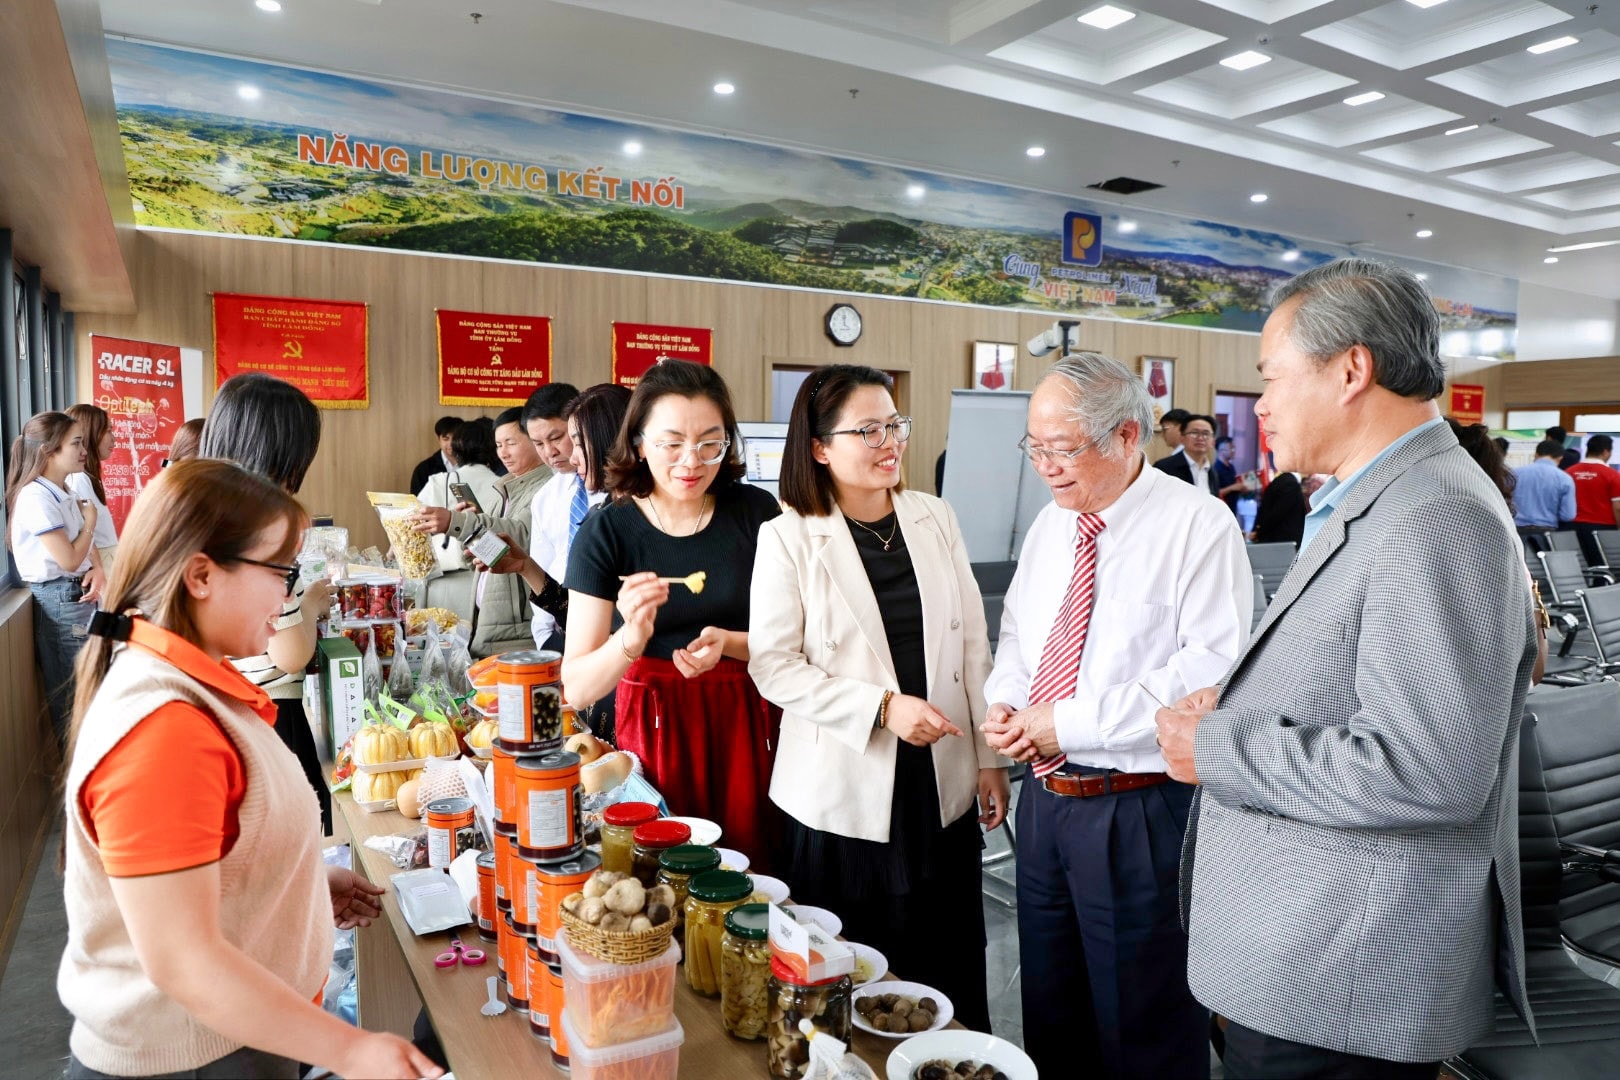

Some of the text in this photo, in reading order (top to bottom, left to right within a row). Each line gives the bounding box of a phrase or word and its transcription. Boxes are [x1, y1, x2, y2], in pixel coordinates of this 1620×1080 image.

[297, 131, 685, 209] NĂNG LƯỢNG KẾT NỐI
[1003, 254, 1040, 288] Cùng
[1051, 267, 1112, 283] PETROLIMEX
[1043, 279, 1117, 305] VIỆT NAM
[1115, 272, 1161, 304] Xanh
[98, 351, 175, 376] RACER SL
[99, 395, 153, 414] OptiTech
[104, 464, 150, 475] JASO MA2
